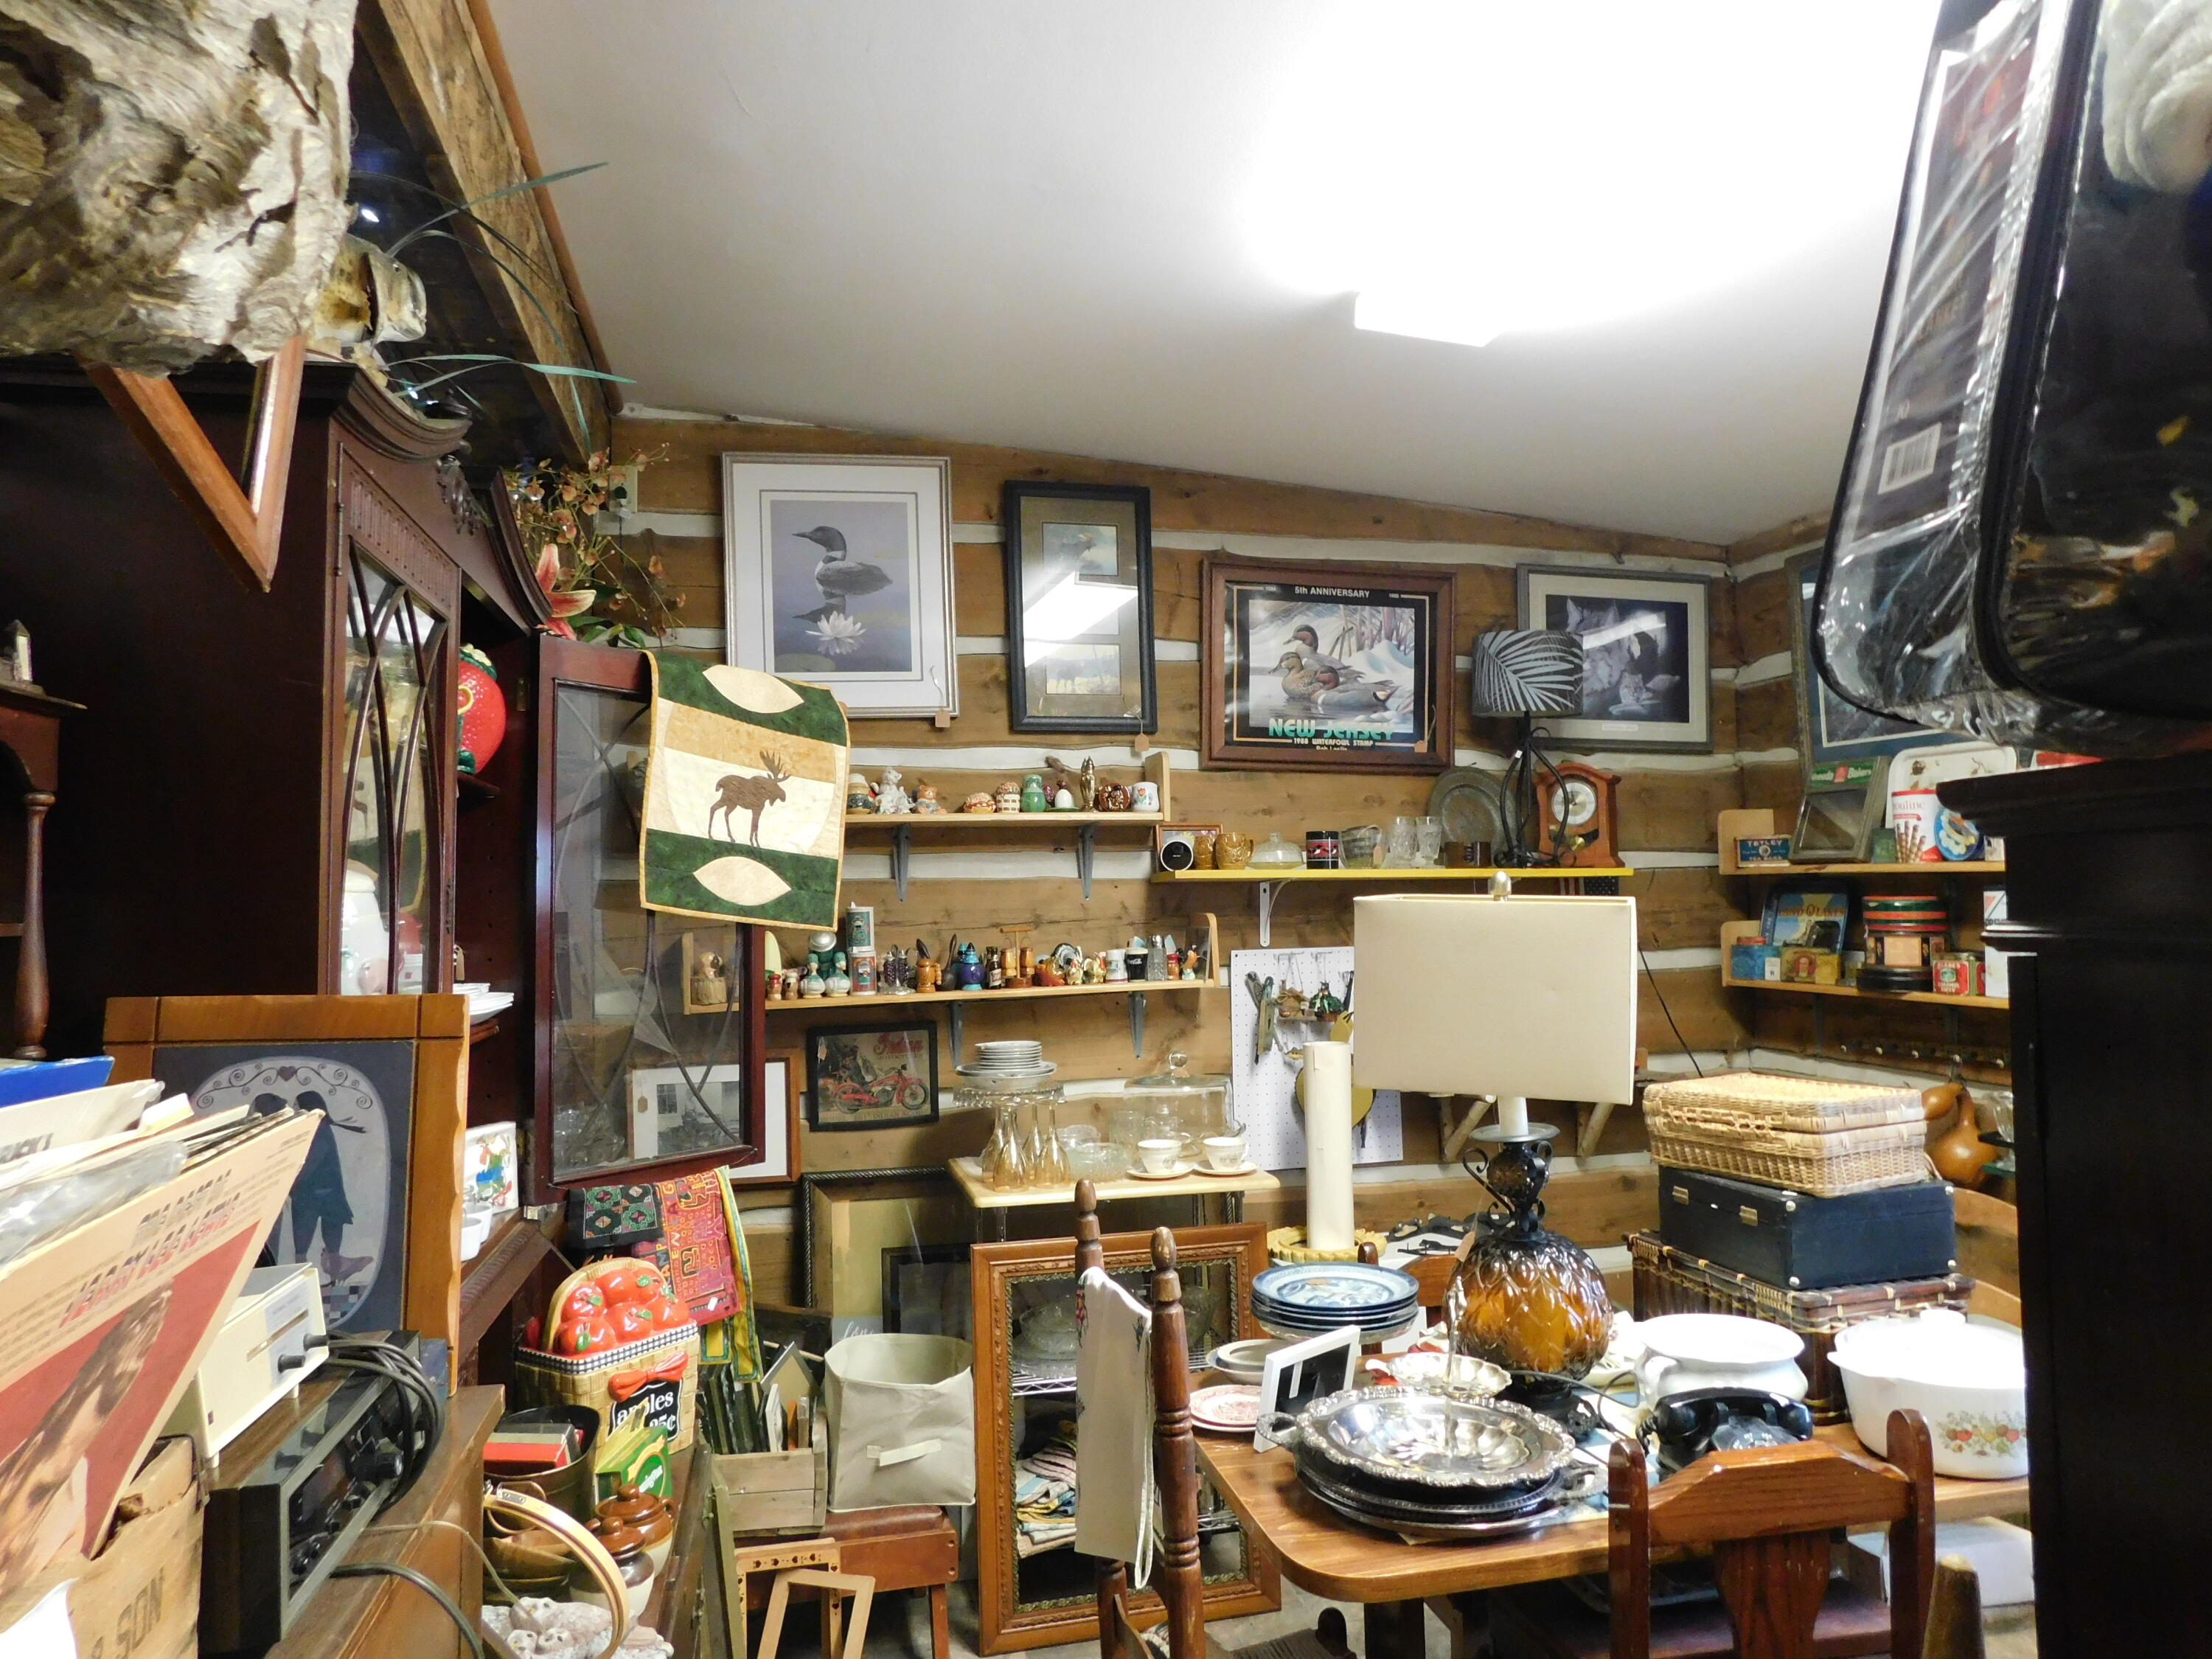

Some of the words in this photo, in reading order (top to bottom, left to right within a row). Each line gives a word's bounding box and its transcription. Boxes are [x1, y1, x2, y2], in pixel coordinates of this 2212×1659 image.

[1295, 586, 1307, 595] 5th
[1310, 588, 1370, 599] ANNIVERSARY
[1269, 717, 1315, 737] NEW
[1324, 720, 1394, 740] JERSEY
